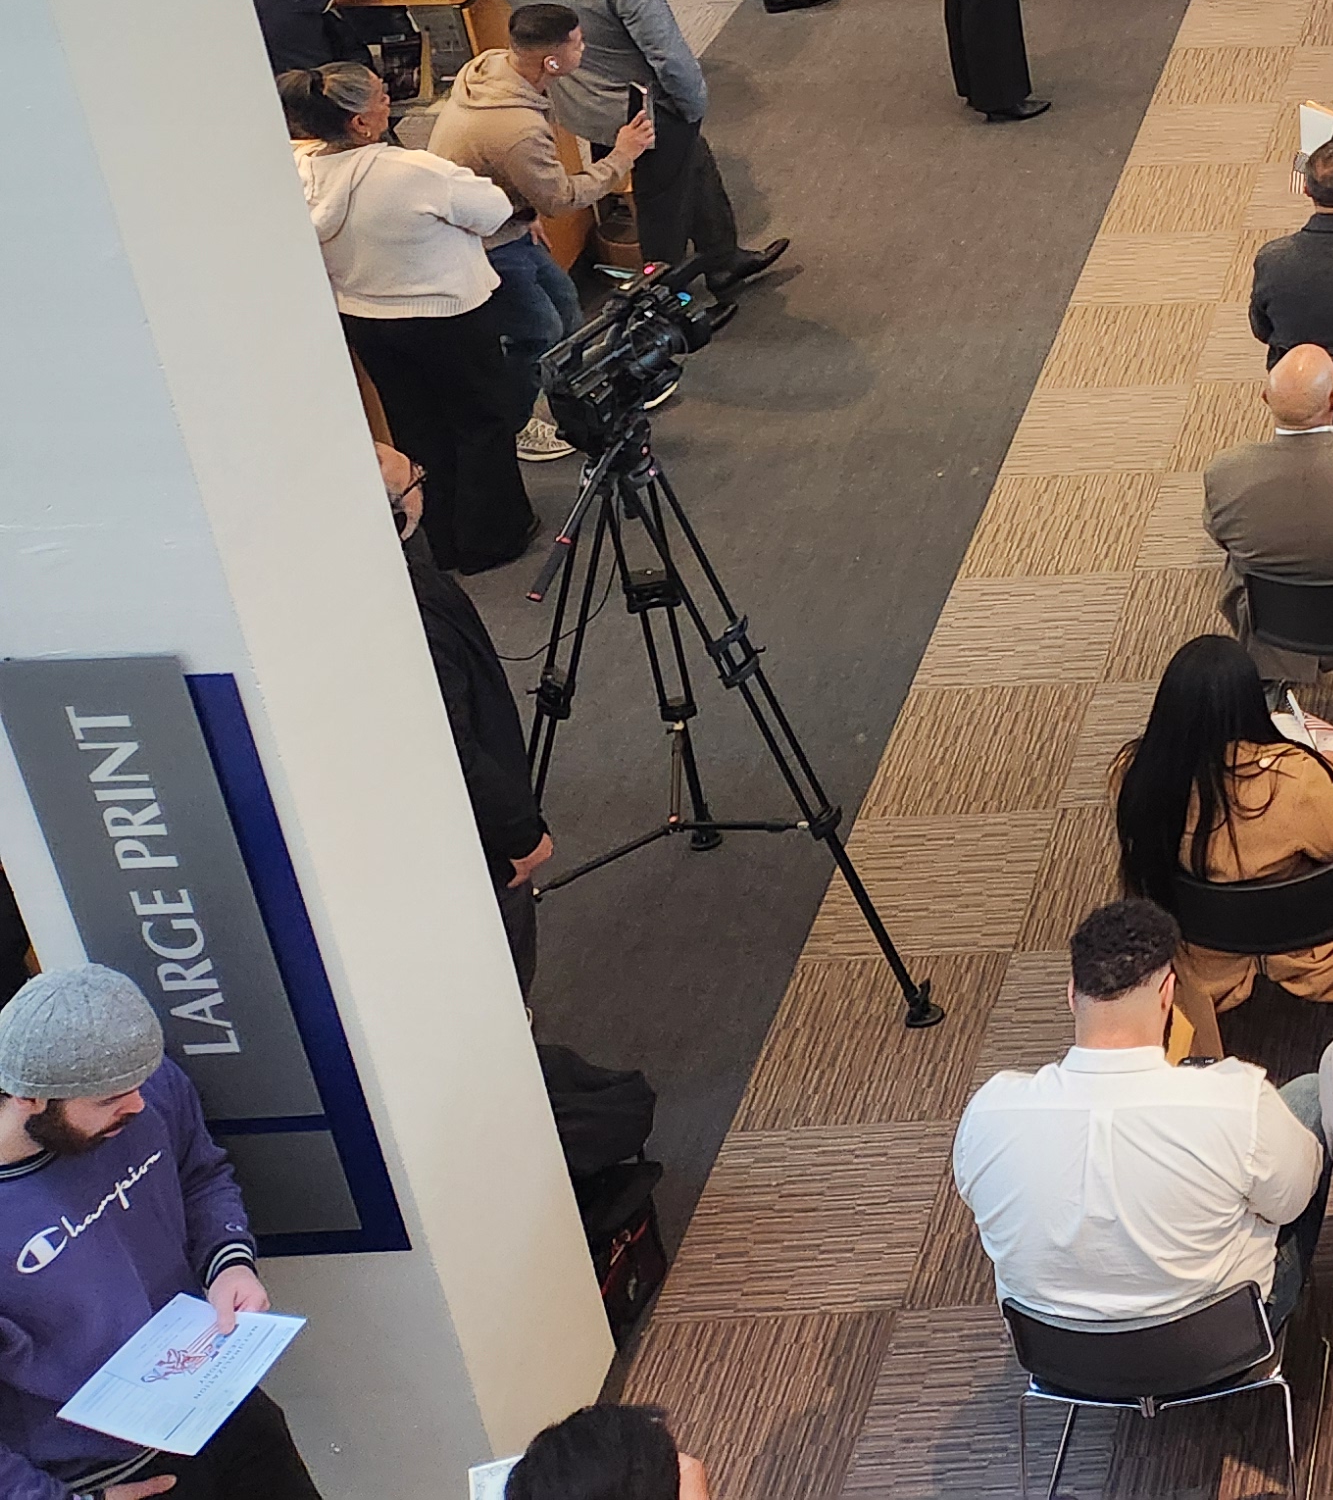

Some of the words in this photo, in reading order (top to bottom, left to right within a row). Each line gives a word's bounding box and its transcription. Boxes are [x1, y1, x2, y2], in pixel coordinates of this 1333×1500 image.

[65, 705, 179, 870] PRINT
[129, 888, 240, 1055] LARGE
[16, 1150, 161, 1274] Champion
